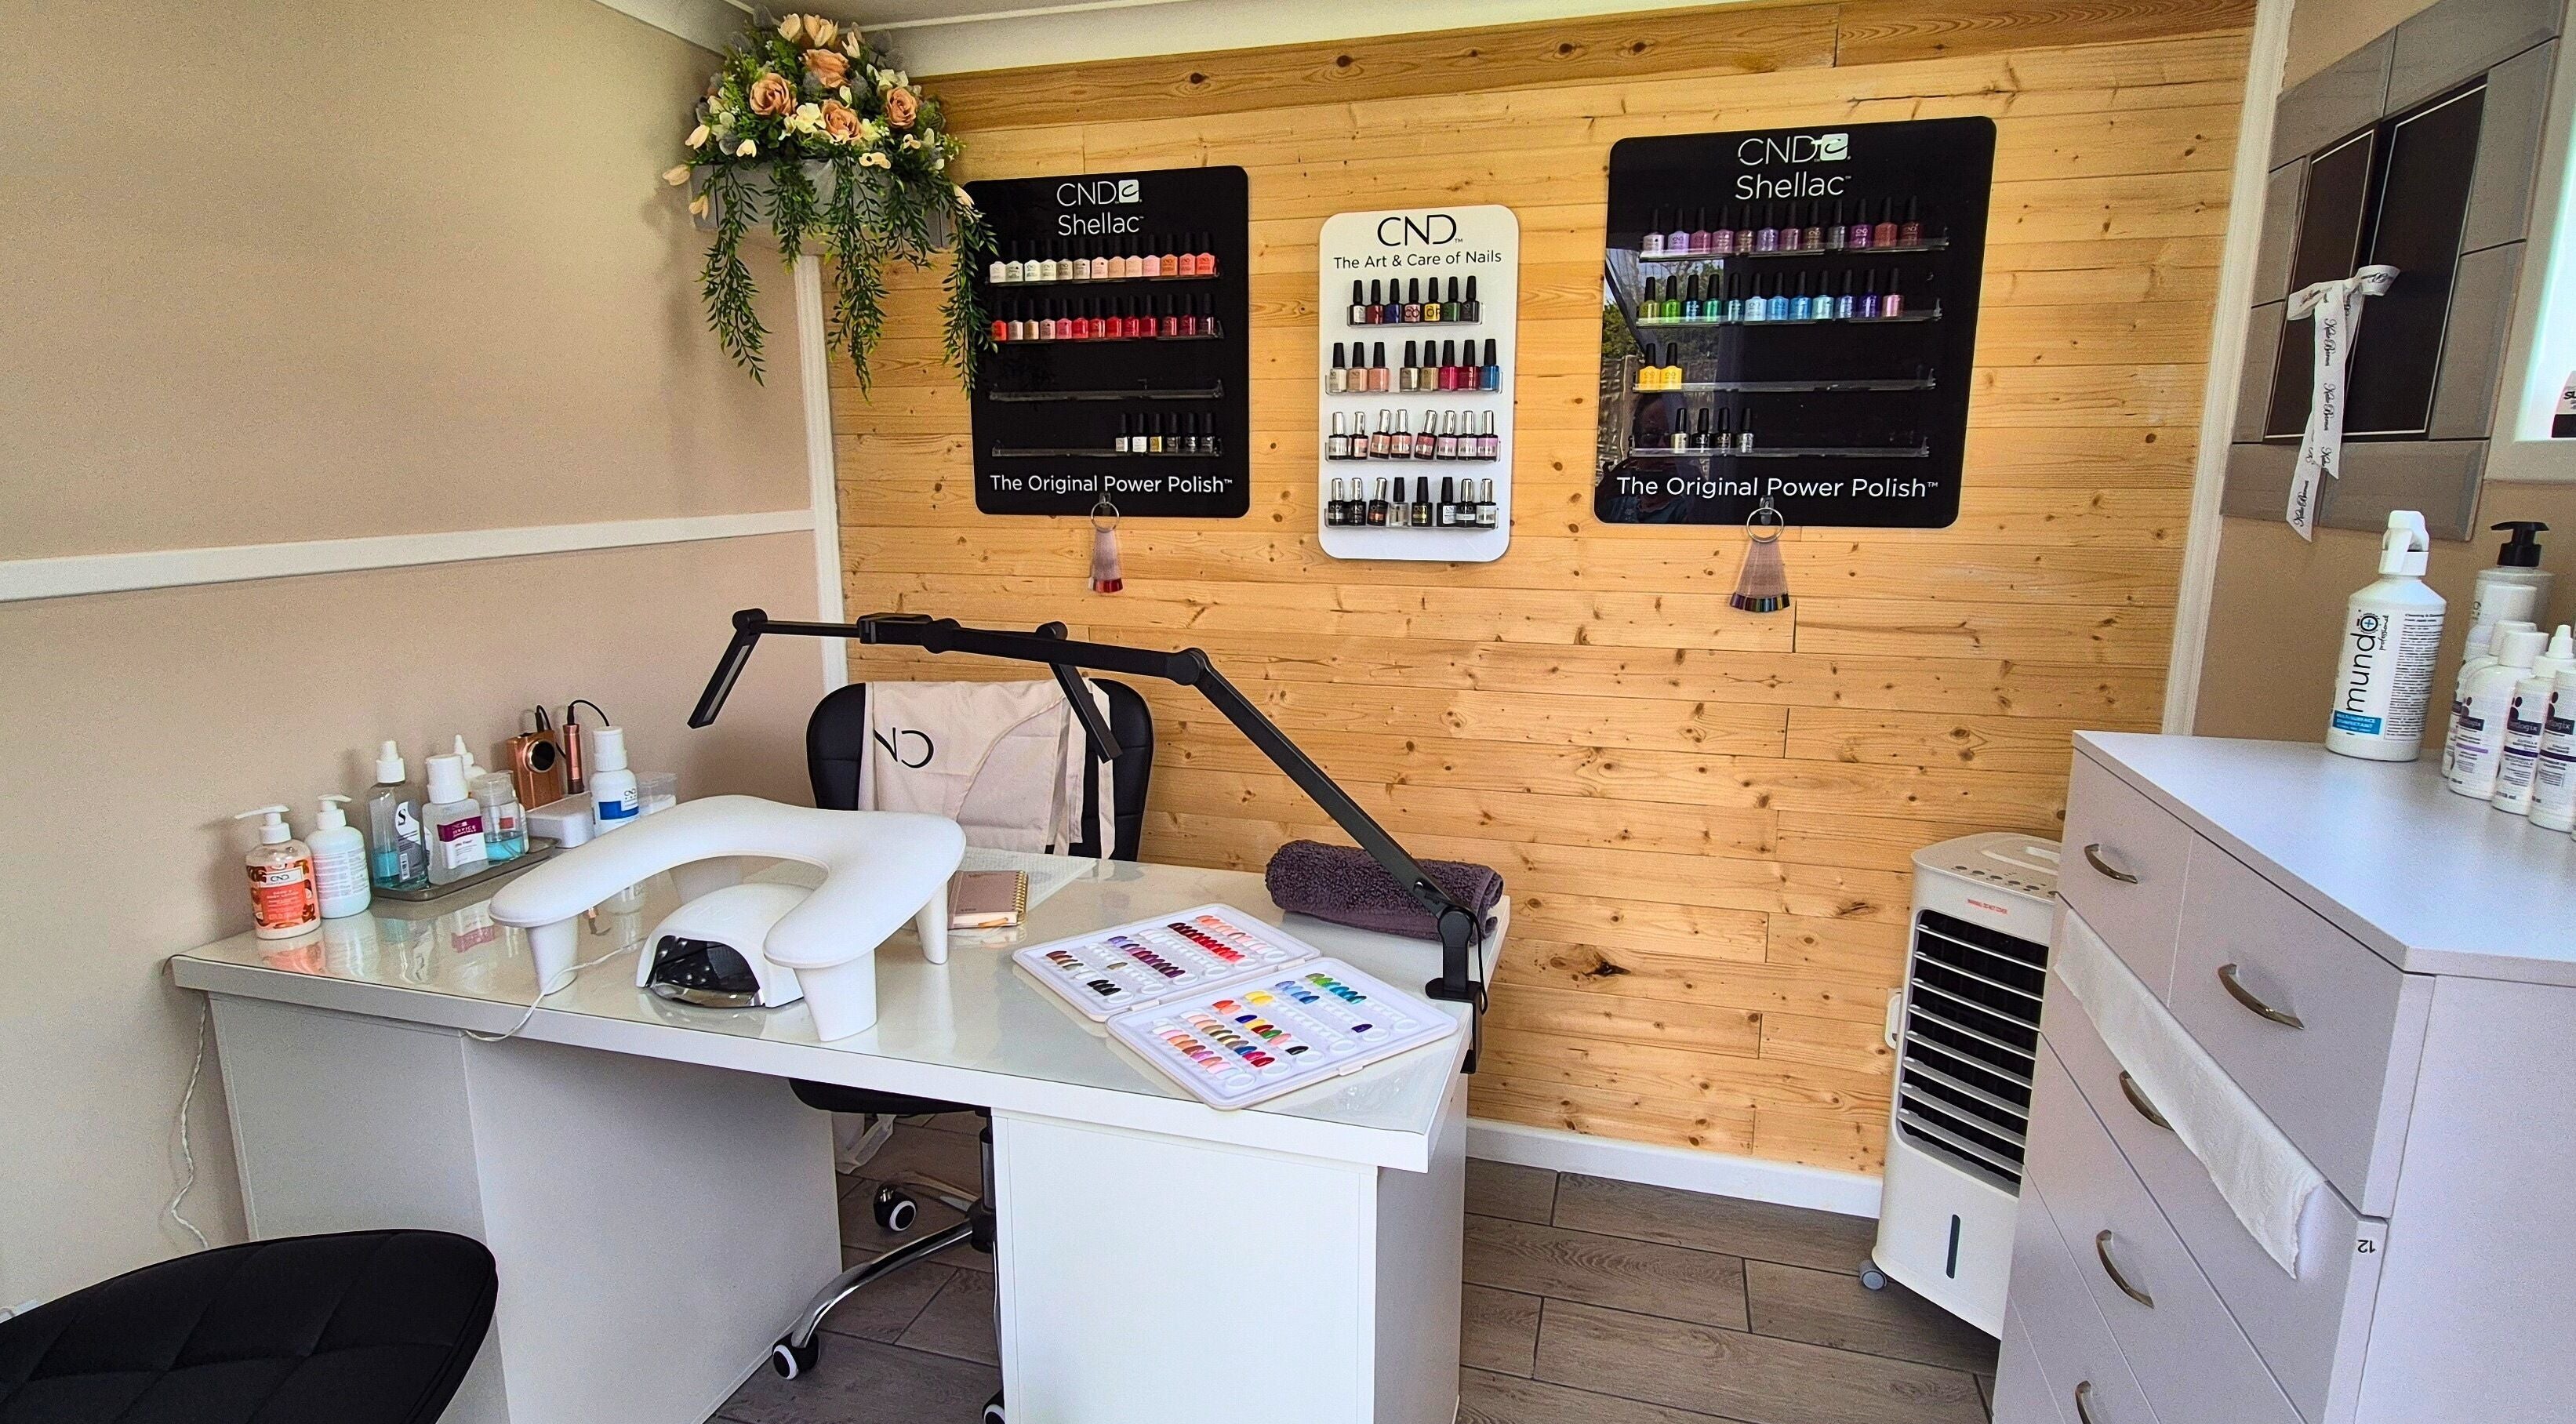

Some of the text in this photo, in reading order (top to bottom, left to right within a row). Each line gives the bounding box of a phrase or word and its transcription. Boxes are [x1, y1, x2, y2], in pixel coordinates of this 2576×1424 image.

[1738, 135, 1818, 166] CND
[1056, 180, 1117, 207] CND
[1735, 171, 1845, 200] Shellac
[1058, 212, 1139, 236] Shellac
[1333, 249, 1502, 269] The Art & Care of Nails
[990, 474, 1023, 491] The
[1028, 474, 1098, 495] Original
[1104, 475, 1162, 492] Power
[1616, 476, 1659, 495] The
[1666, 475, 1758, 499] Original
[1768, 478, 1844, 496] Power
[2378, 615, 2389, 651] professional
[2357, 1239, 2376, 1254] 12
